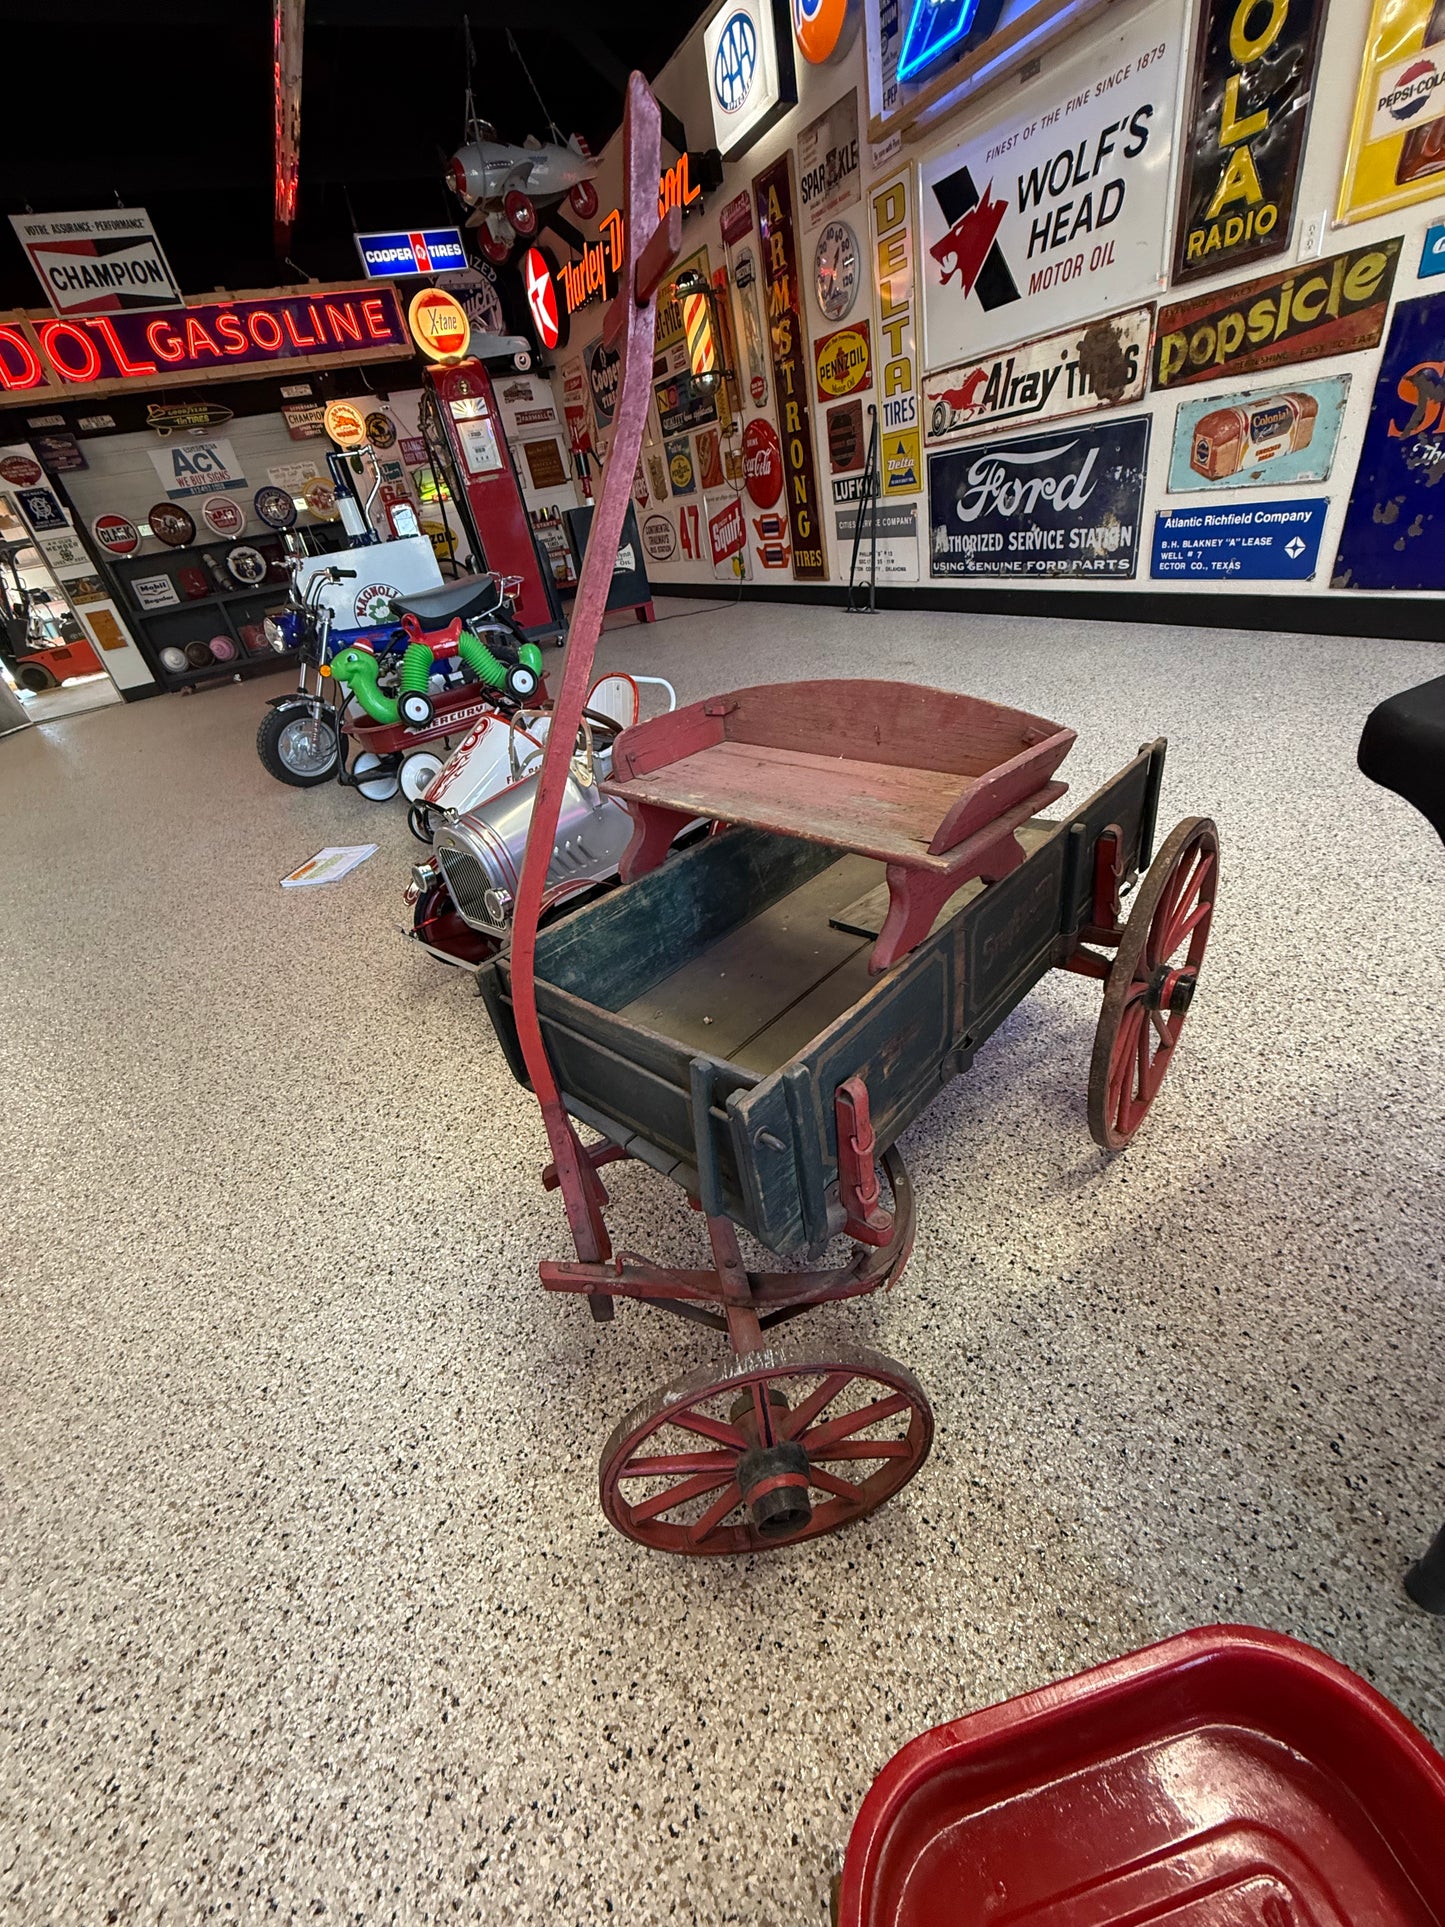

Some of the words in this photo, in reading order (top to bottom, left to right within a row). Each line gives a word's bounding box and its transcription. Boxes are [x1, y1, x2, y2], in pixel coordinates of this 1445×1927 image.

[715, 20, 753, 105] AAA
[985, 132, 1018, 164] FINEST
[1022, 123, 1038, 142] OF
[1040, 112, 1061, 135] THE
[1065, 94, 1090, 118] FINE
[1095, 65, 1130, 98] SINCE
[1136, 42, 1167, 71] 1879
[1017, 103, 1154, 215] WOLF'S
[24, 224, 50, 237] VOTRE
[1027, 177, 1126, 260] HEAD
[1186, 203, 1279, 262] RADIO
[835, 227, 843, 242] 60
[366, 247, 414, 264] COOPER
[427, 243, 463, 258] TIRES
[1027, 258, 1084, 297] MOTOR
[1089, 239, 1116, 273] OIL
[49, 259, 164, 291] CHAMPION
[873, 181, 913, 398] DELTA
[146, 299, 392, 363] GASOLINE
[428, 307, 458, 336] X-tane
[1157, 252, 1388, 386] popsicle
[767, 183, 813, 538] ARMSTRONG
[819, 345, 867, 382] PENNZOIL
[1299, 345, 1325, 357] EASY
[591, 360, 620, 393] Cooper
[831, 383, 846, 394] Motor
[847, 379, 856, 391] Oil
[981, 357, 1062, 415] Alray
[288, 407, 325, 425] CHAMPION
[883, 395, 915, 427] TIRES
[1252, 408, 1290, 428] Colonial
[742, 448, 773, 479] Coca-Cola
[887, 458, 915, 472] Delta
[175, 476, 191, 488] WE
[190, 474, 207, 486] BUY
[207, 470, 231, 483] SIGNS
[834, 475, 878, 501] LUFK
[955, 438, 1100, 523] Ford
[680, 504, 702, 560] 47
[712, 506, 743, 553] Squirt
[838, 520, 857, 530] CITIES
[882, 516, 914, 527] COMPANY
[1164, 515, 1202, 529] Atlantic
[1204, 511, 1252, 527] Richfield
[1254, 510, 1313, 526] Company
[101, 525, 136, 544] CLARK
[933, 525, 1003, 554] AUTHORIZED
[1008, 531, 1066, 552] SERVICE
[1068, 526, 1133, 552] STATION
[1161, 540, 1180, 549] B.H.
[1182, 538, 1224, 548] BLAKNEY
[1242, 537, 1273, 546] LEASE
[793, 549, 823, 569] TIRES
[933, 562, 965, 571] USING
[968, 561, 1023, 571] GENUINE
[1026, 560, 1069, 571] FORD
[1072, 558, 1131, 571] PARTS
[1159, 562, 1186, 571] ECTOR
[1211, 562, 1241, 571] TEXAS
[1161, 552, 1184, 560] WELL
[1187, 550, 1194, 558] #
[1196, 551, 1203, 559] 7
[140, 582, 167, 593] Mobil
[356, 585, 400, 617] MAGNOLI
